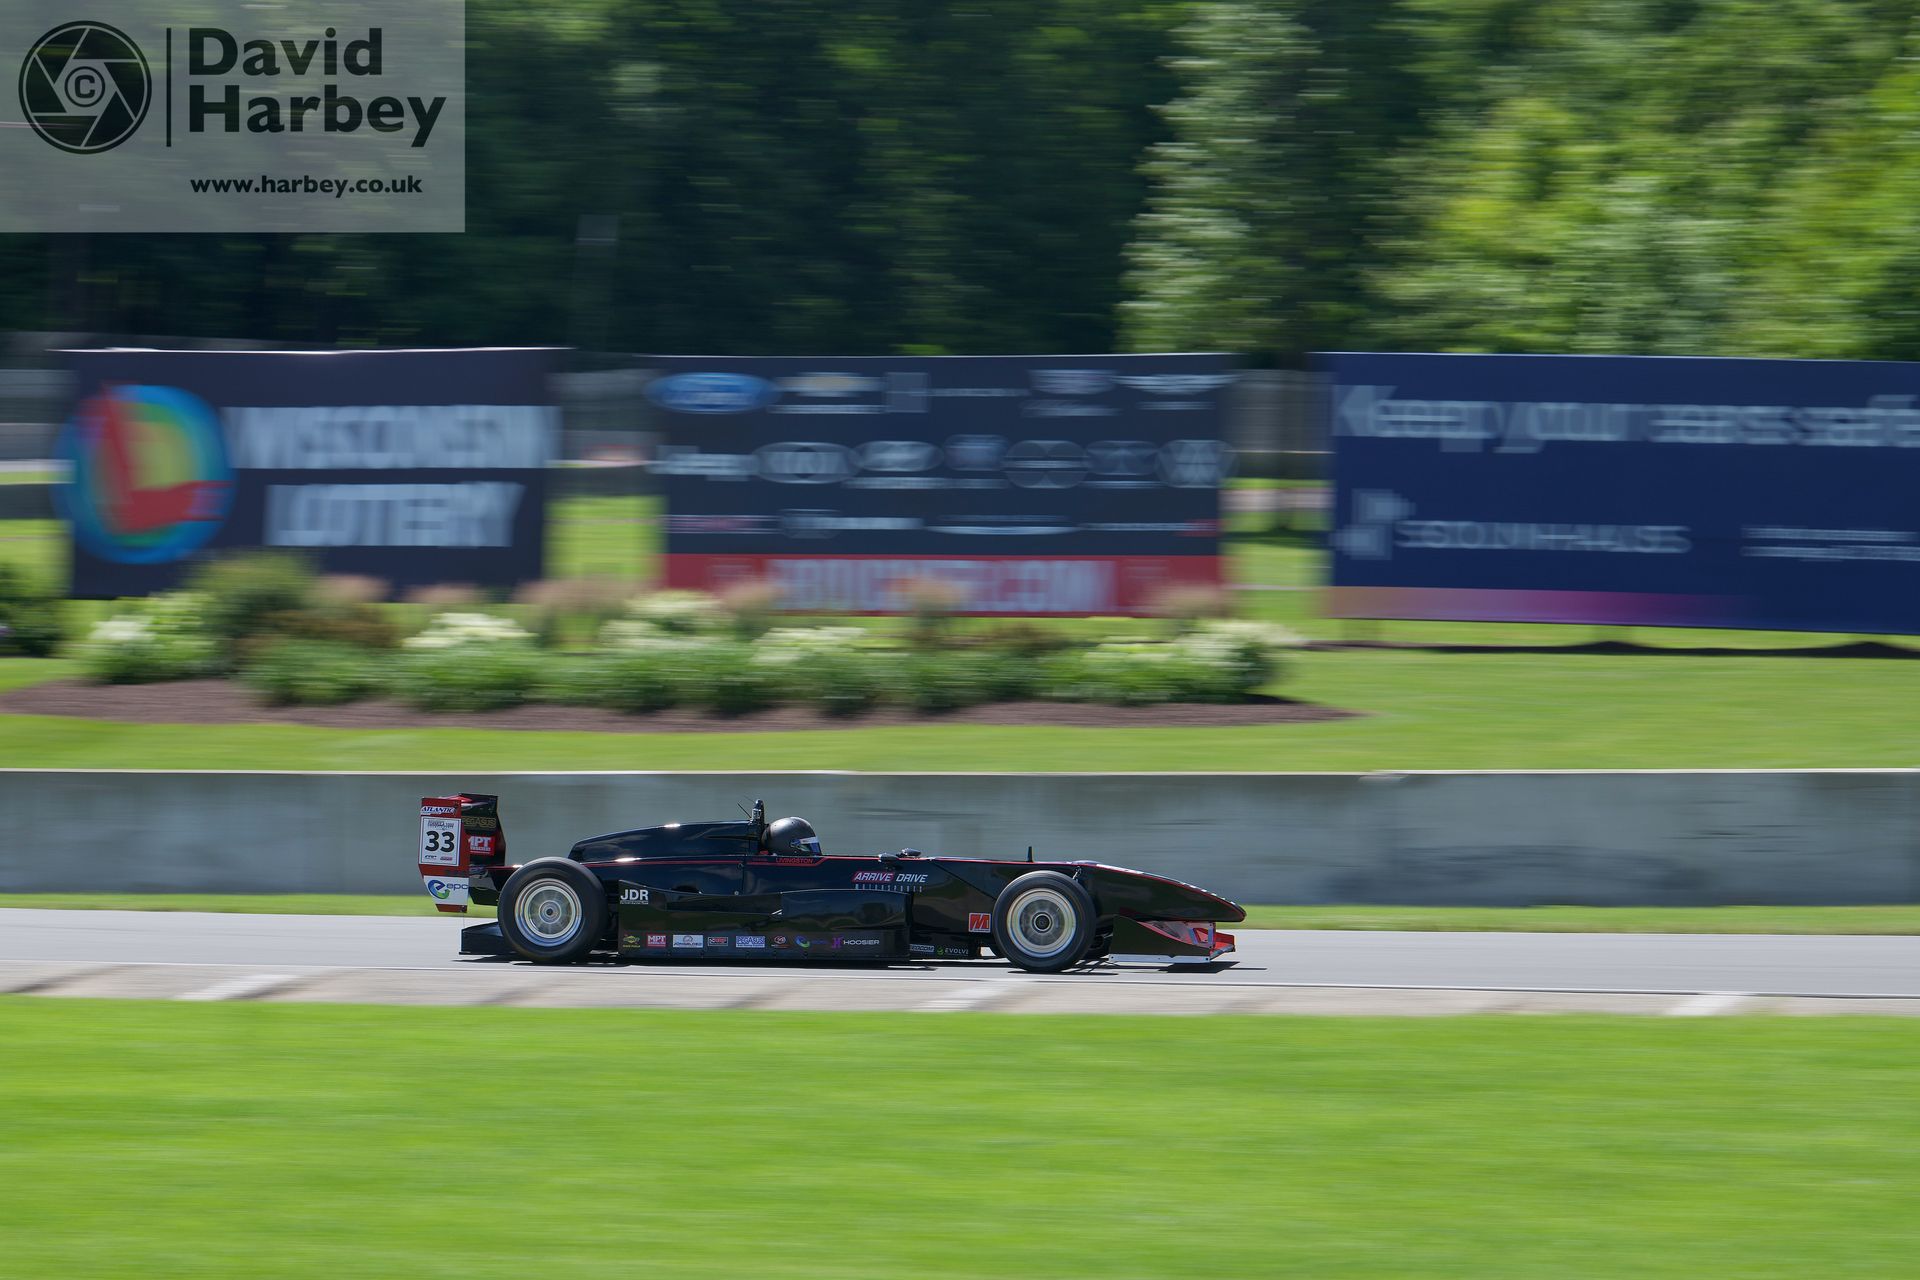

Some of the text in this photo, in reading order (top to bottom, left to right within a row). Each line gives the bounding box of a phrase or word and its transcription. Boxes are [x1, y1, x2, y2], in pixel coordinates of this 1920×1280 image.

[425, 831, 454, 852] 33
[854, 872, 928, 883] ARRIVE DRIVE
[620, 889, 649, 900] JDR
